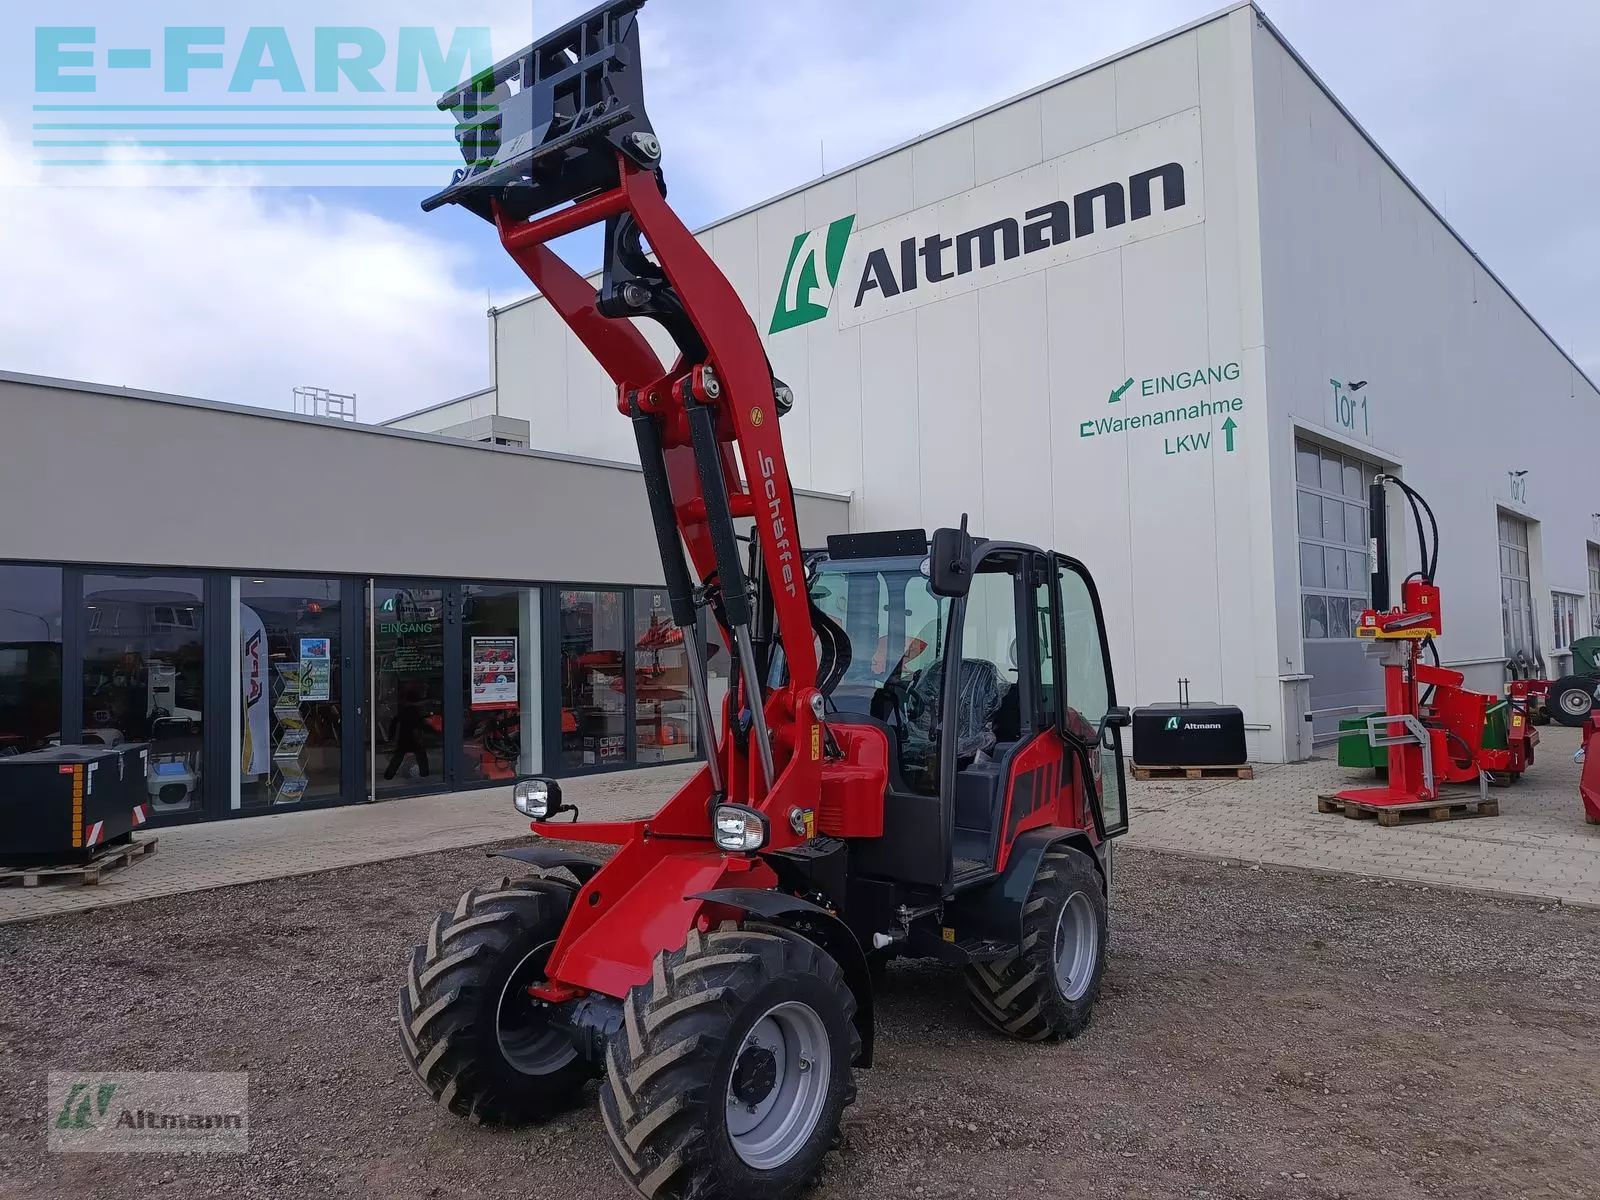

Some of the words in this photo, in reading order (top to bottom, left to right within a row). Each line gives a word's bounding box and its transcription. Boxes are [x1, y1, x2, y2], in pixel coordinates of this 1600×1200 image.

[854, 162, 1186, 308] Altmann
[1141, 362, 1241, 398] EINGANG
[1095, 397, 1243, 436] Warenannahme
[1329, 378, 1357, 429] Tor
[1361, 395, 1369, 436] 1
[1164, 431, 1211, 455] LKW
[757, 450, 795, 598] Schäffer
[380, 623, 433, 634] EINGANG
[1184, 722, 1222, 730] Altmann
